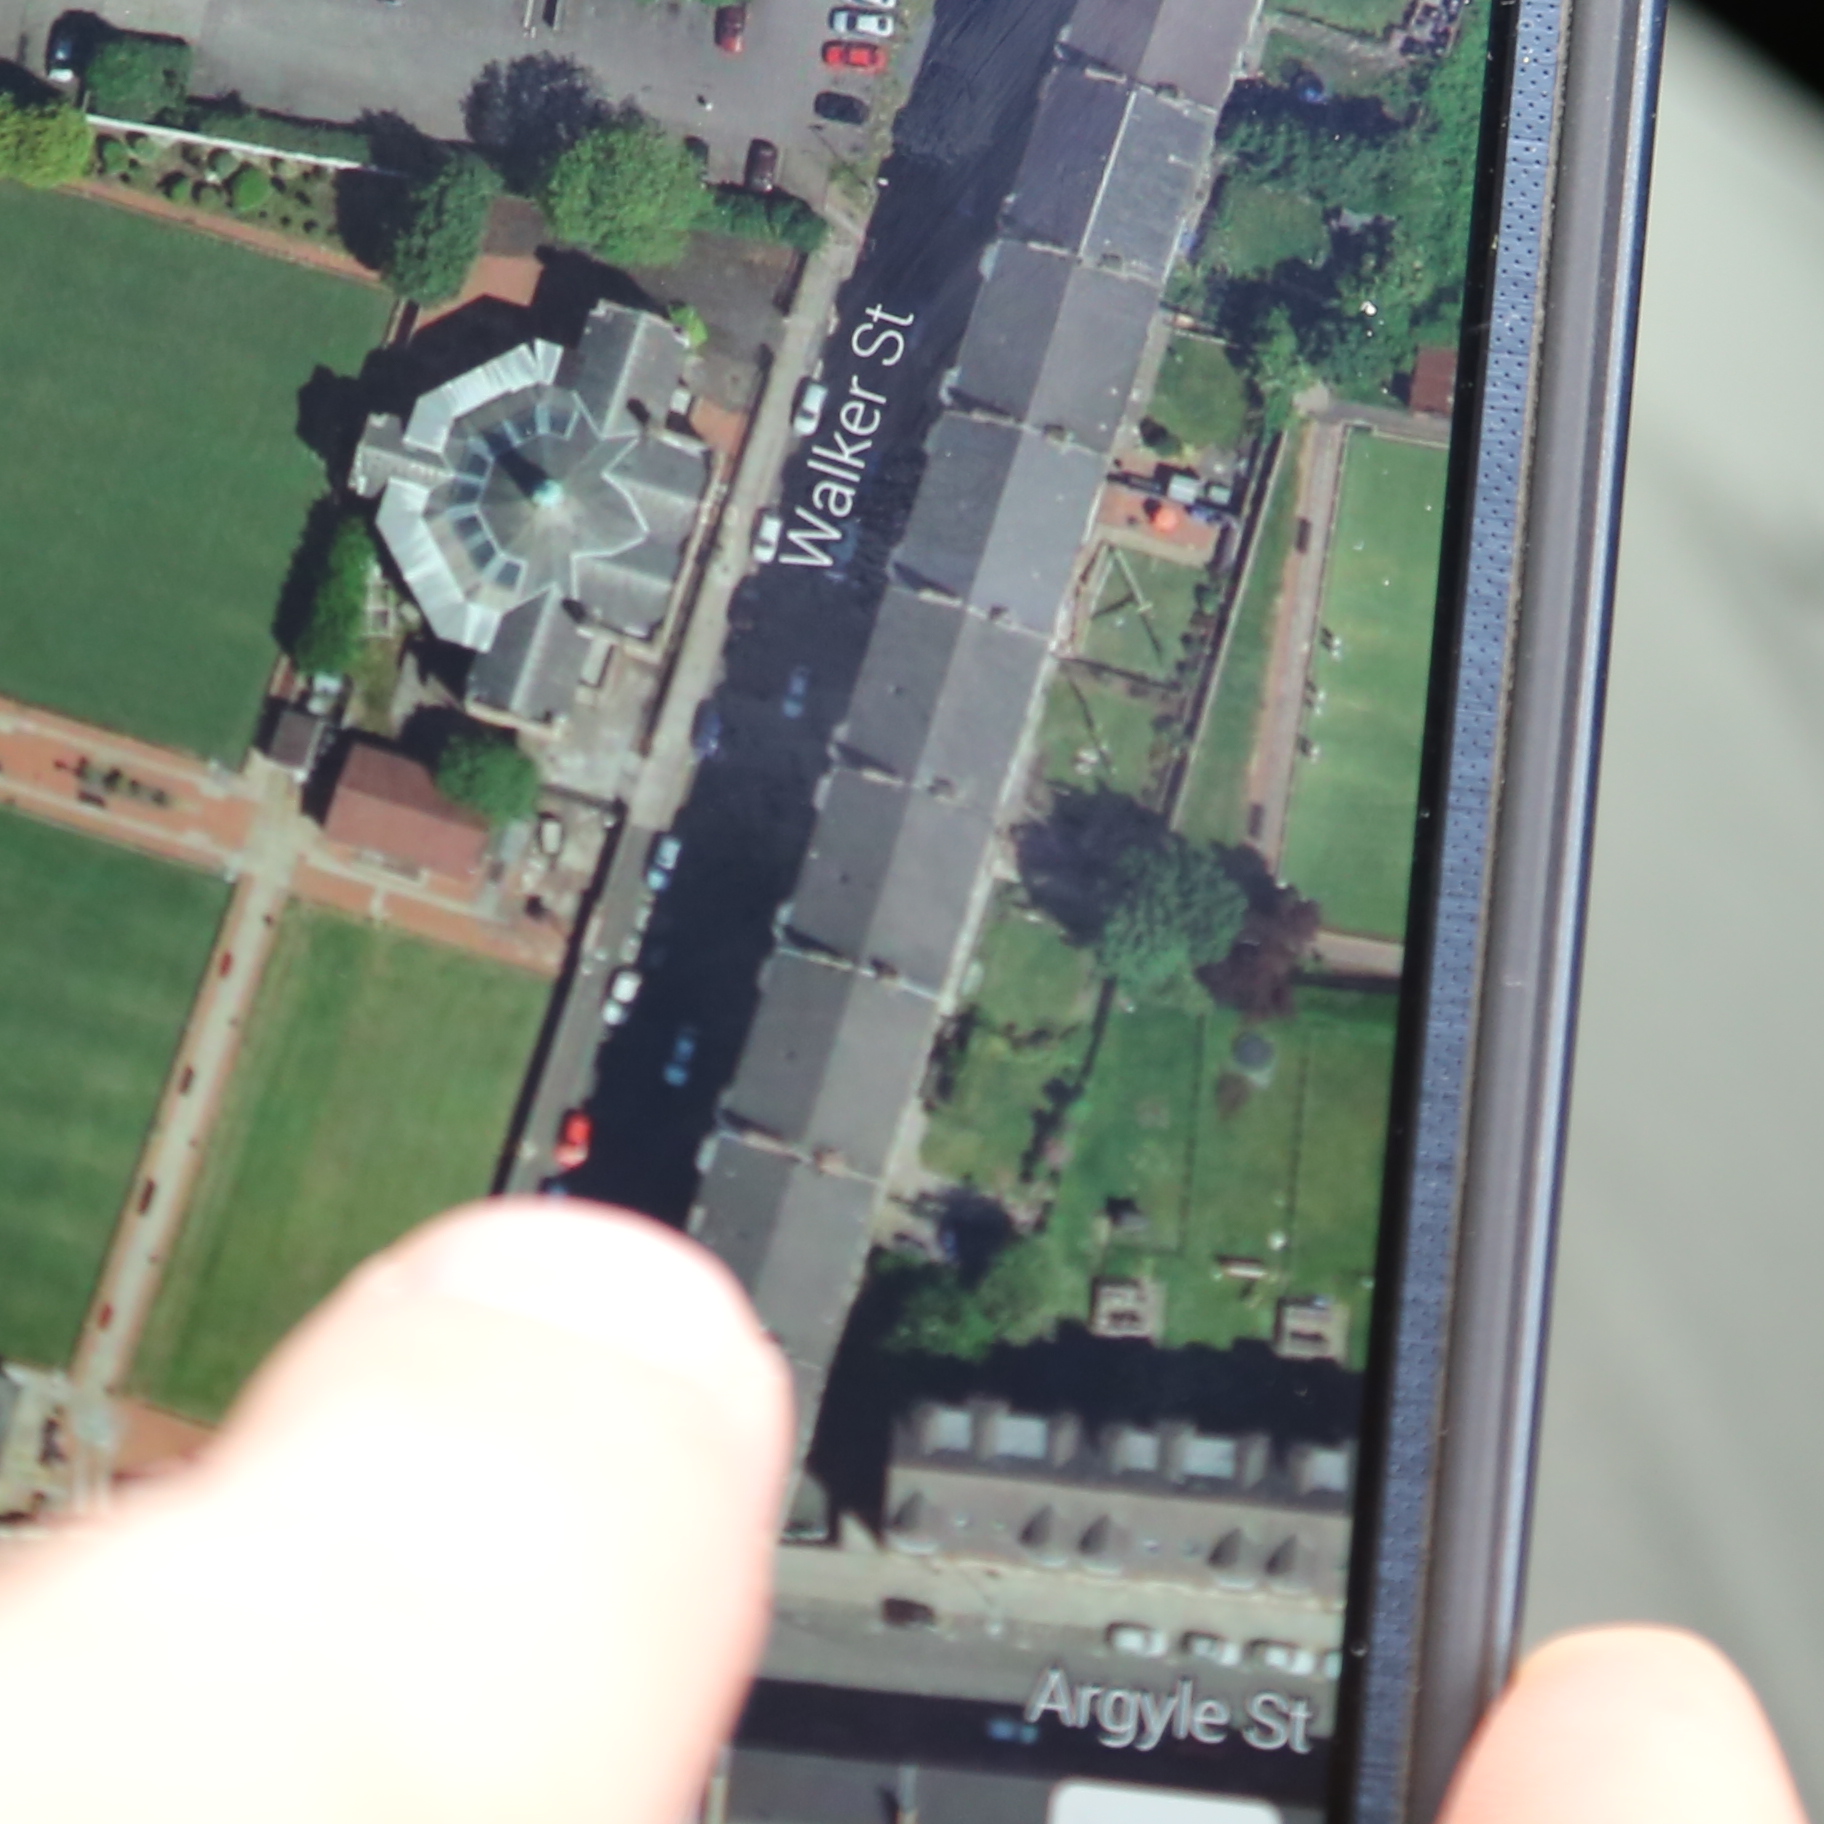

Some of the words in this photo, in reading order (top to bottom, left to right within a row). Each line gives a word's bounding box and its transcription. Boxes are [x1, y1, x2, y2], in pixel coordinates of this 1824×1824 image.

[778, 374, 888, 567] Walker
[850, 302, 915, 367] St
[1025, 1668, 1231, 1752] Argyle
[1241, 1691, 1313, 1755] St
